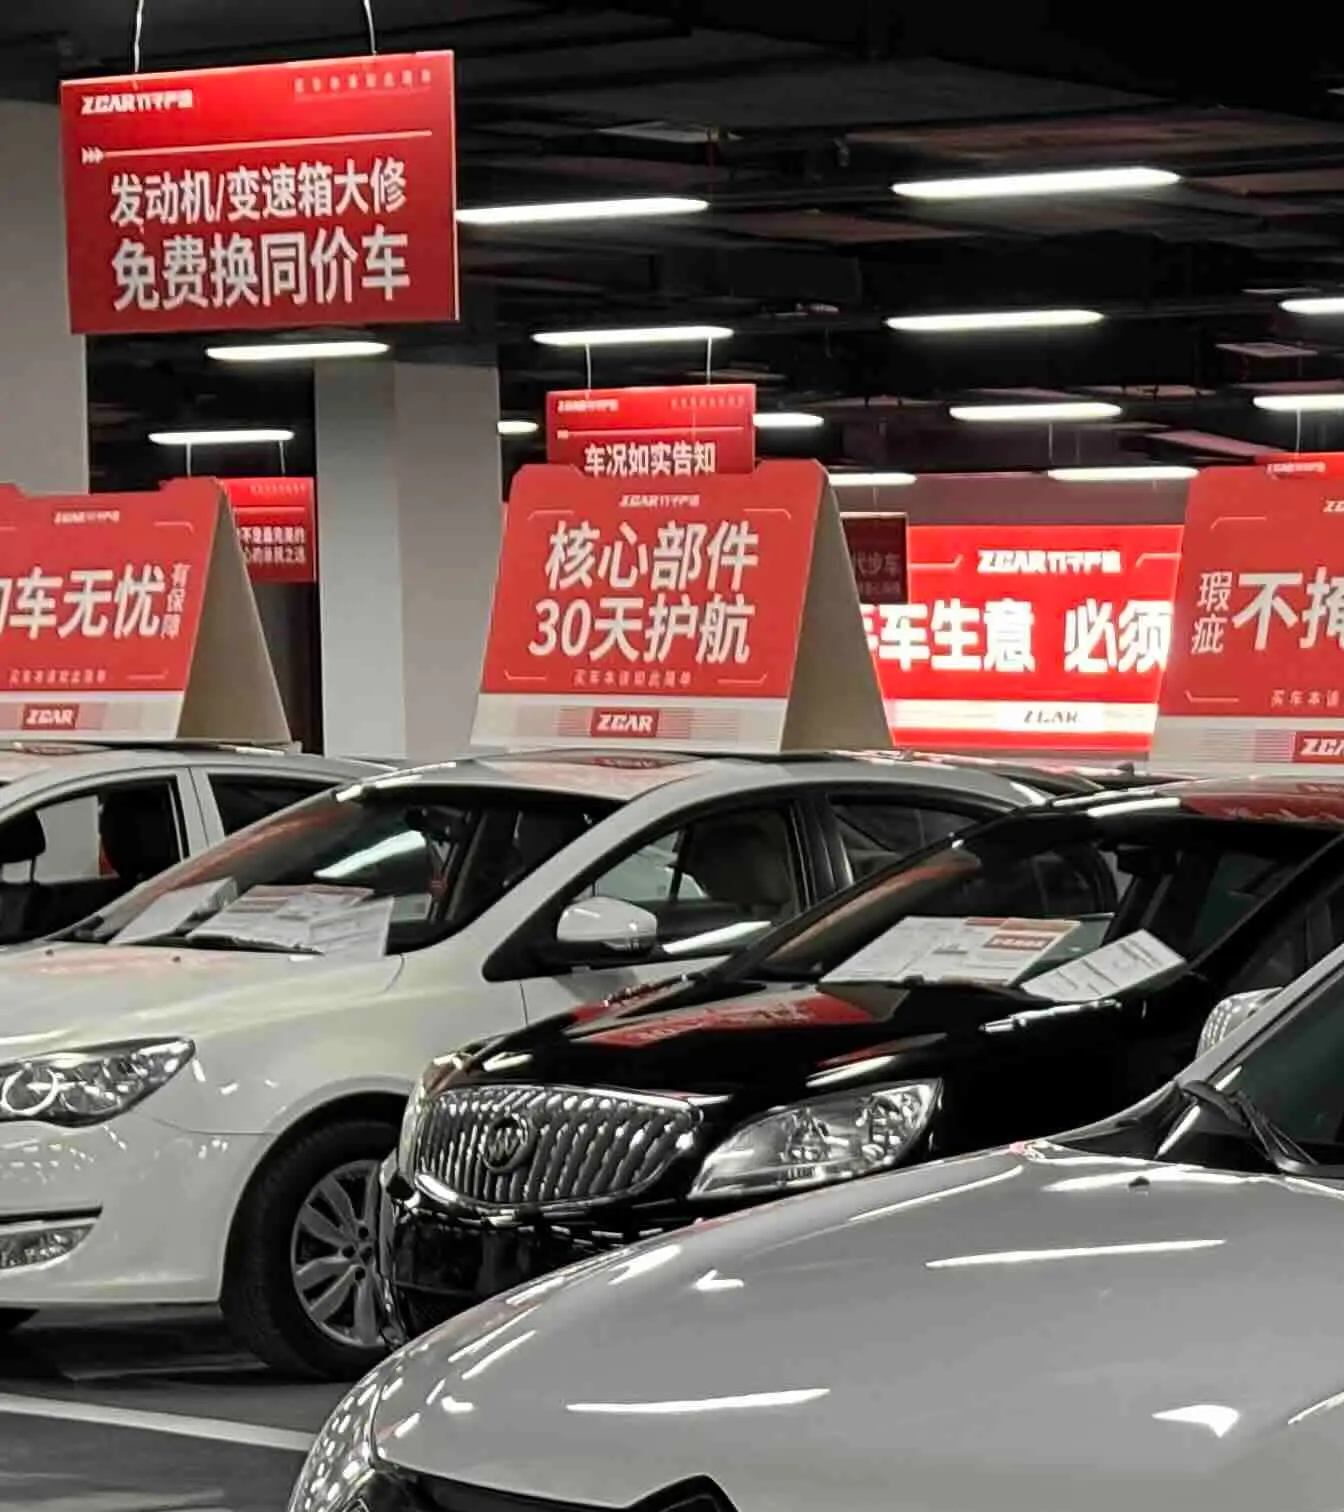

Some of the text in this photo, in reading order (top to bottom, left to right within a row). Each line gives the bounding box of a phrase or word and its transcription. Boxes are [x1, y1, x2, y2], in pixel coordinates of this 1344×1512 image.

[110, 157, 407, 234] 发动机/变速箱大修
[111, 223, 410, 311] 免费换同价车
[584, 440, 716, 477] 车况如实告知
[545, 520, 759, 591] 核心部件
[0, 563, 165, 640] 车无忧
[528, 593, 756, 663] 30天护航
[1064, 598, 1175, 673] 必须
[1190, 571, 1233, 655] 瑕疵
